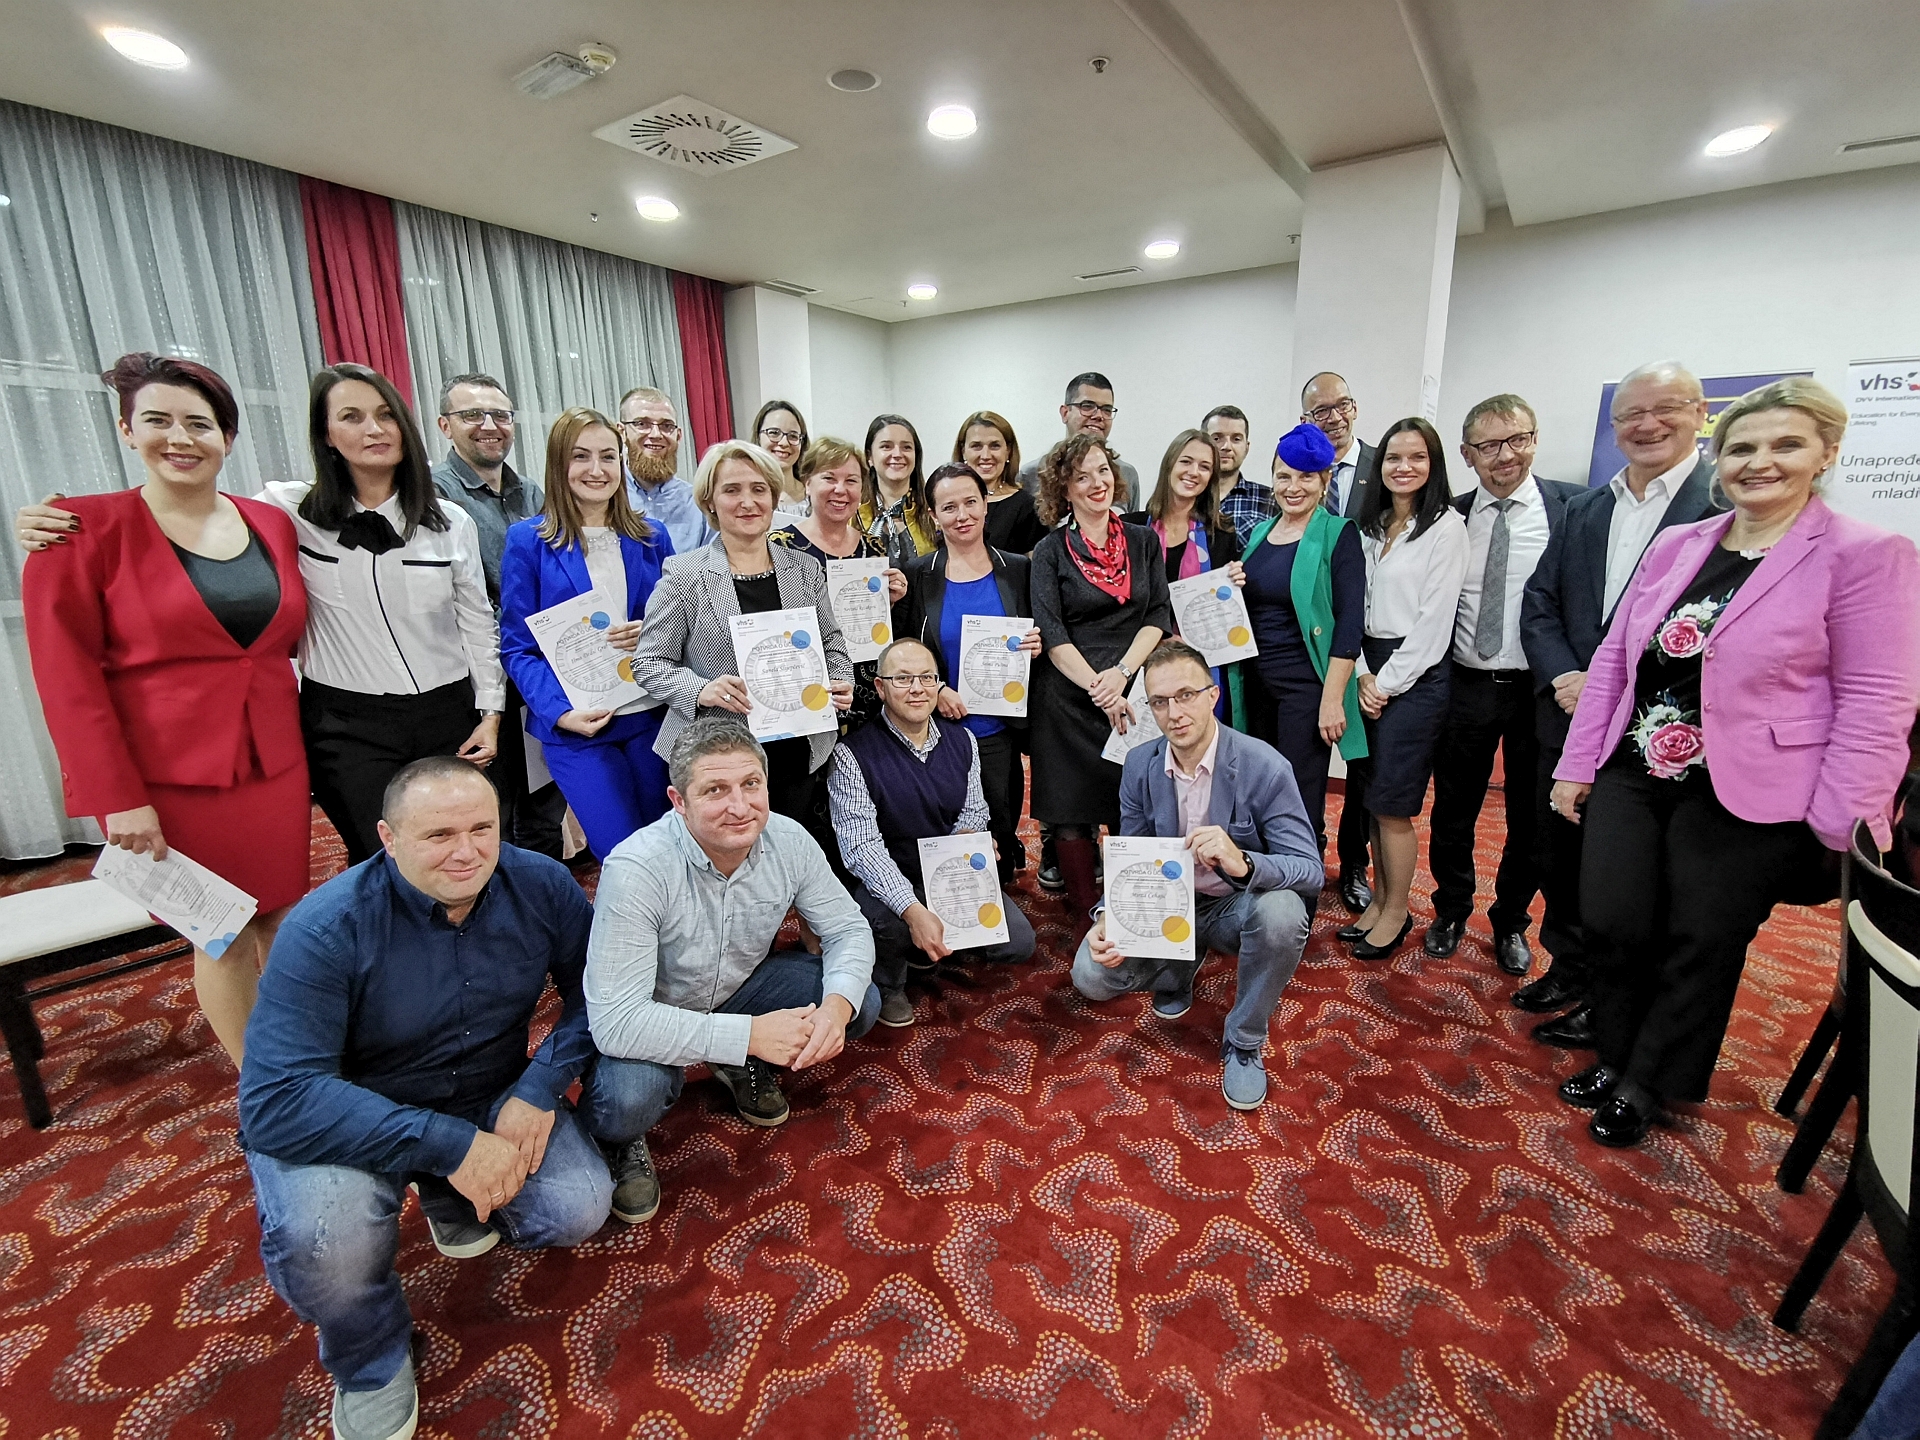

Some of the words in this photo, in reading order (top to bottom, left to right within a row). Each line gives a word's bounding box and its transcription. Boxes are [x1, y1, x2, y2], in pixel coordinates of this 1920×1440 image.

[1860, 373, 1903, 390] vhs
[1845, 471, 1920, 485] suradnju
[534, 618, 545, 626] vhs
